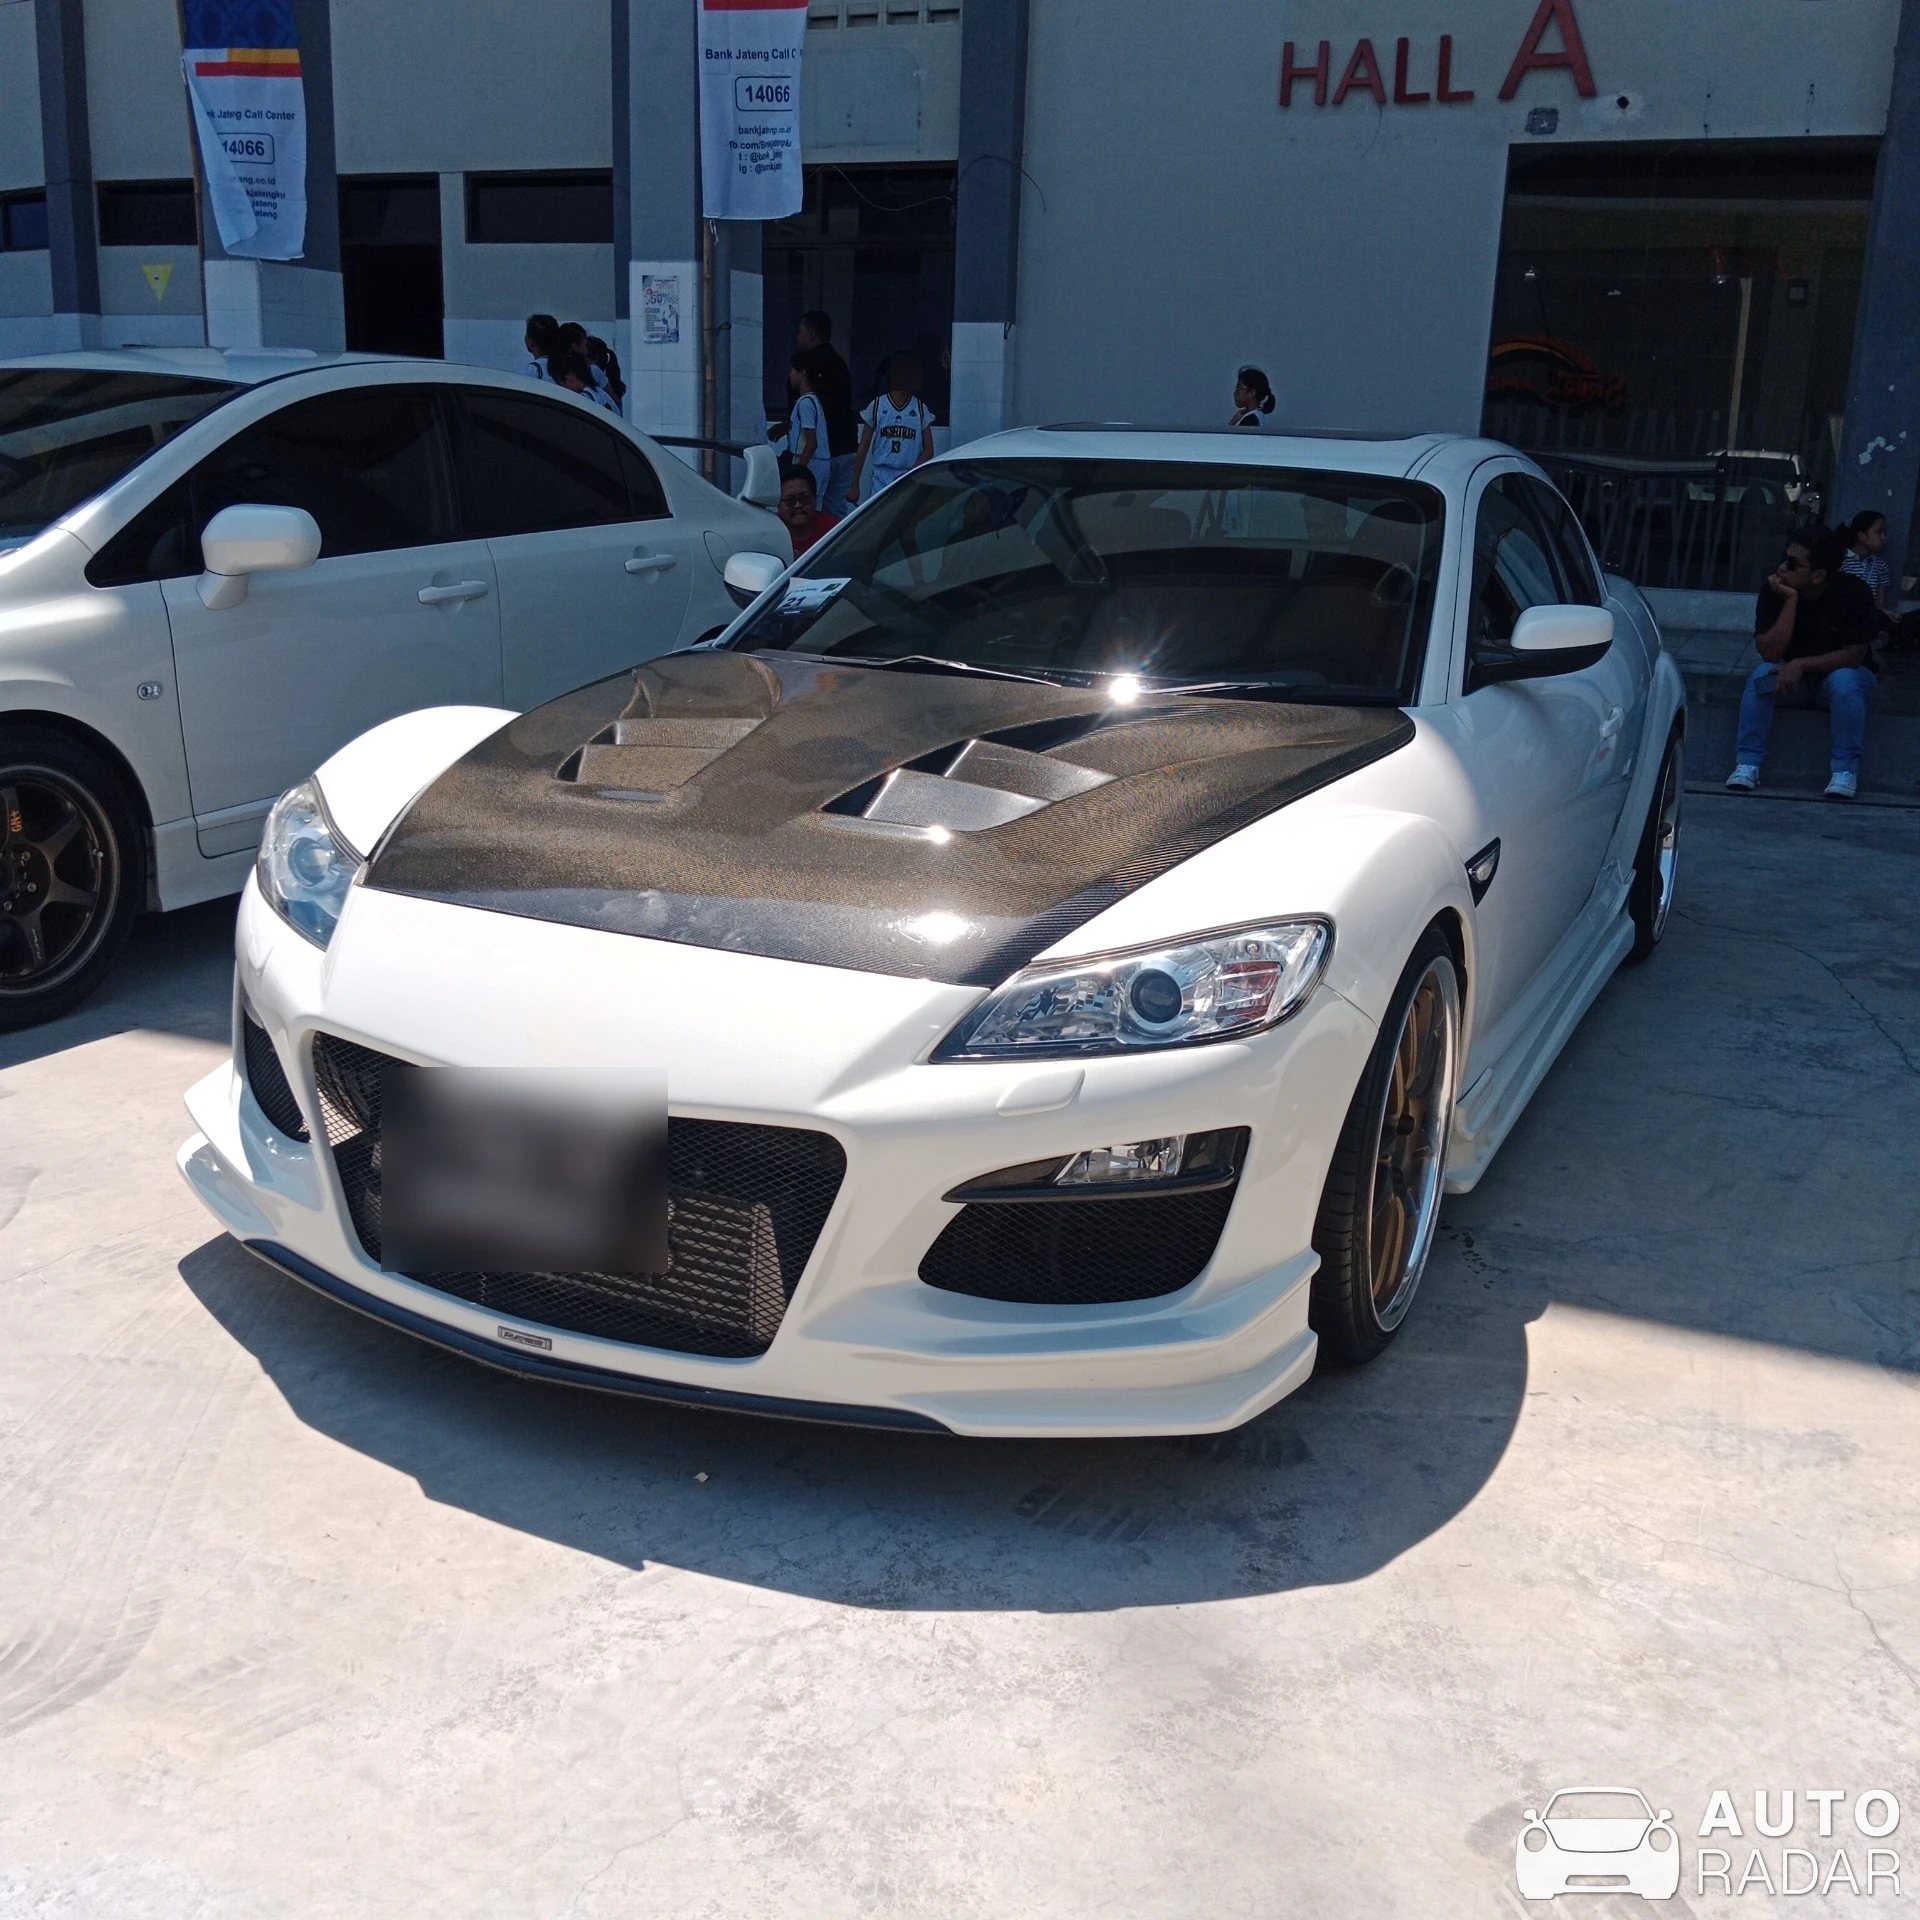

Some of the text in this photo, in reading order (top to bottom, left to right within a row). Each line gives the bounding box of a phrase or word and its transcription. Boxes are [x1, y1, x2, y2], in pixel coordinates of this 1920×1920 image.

[705, 48, 733, 60] Bank
[736, 48, 770, 62] Jateng
[771, 48, 790, 59] Call
[1279, 0, 1598, 107] HALL A
[745, 84, 790, 103] 14066
[244, 109, 263, 120] Call
[265, 110, 296, 121] Center
[221, 139, 265, 157] 14066
[252, 199, 278, 210] jateng
[782, 596, 807, 608] 21
